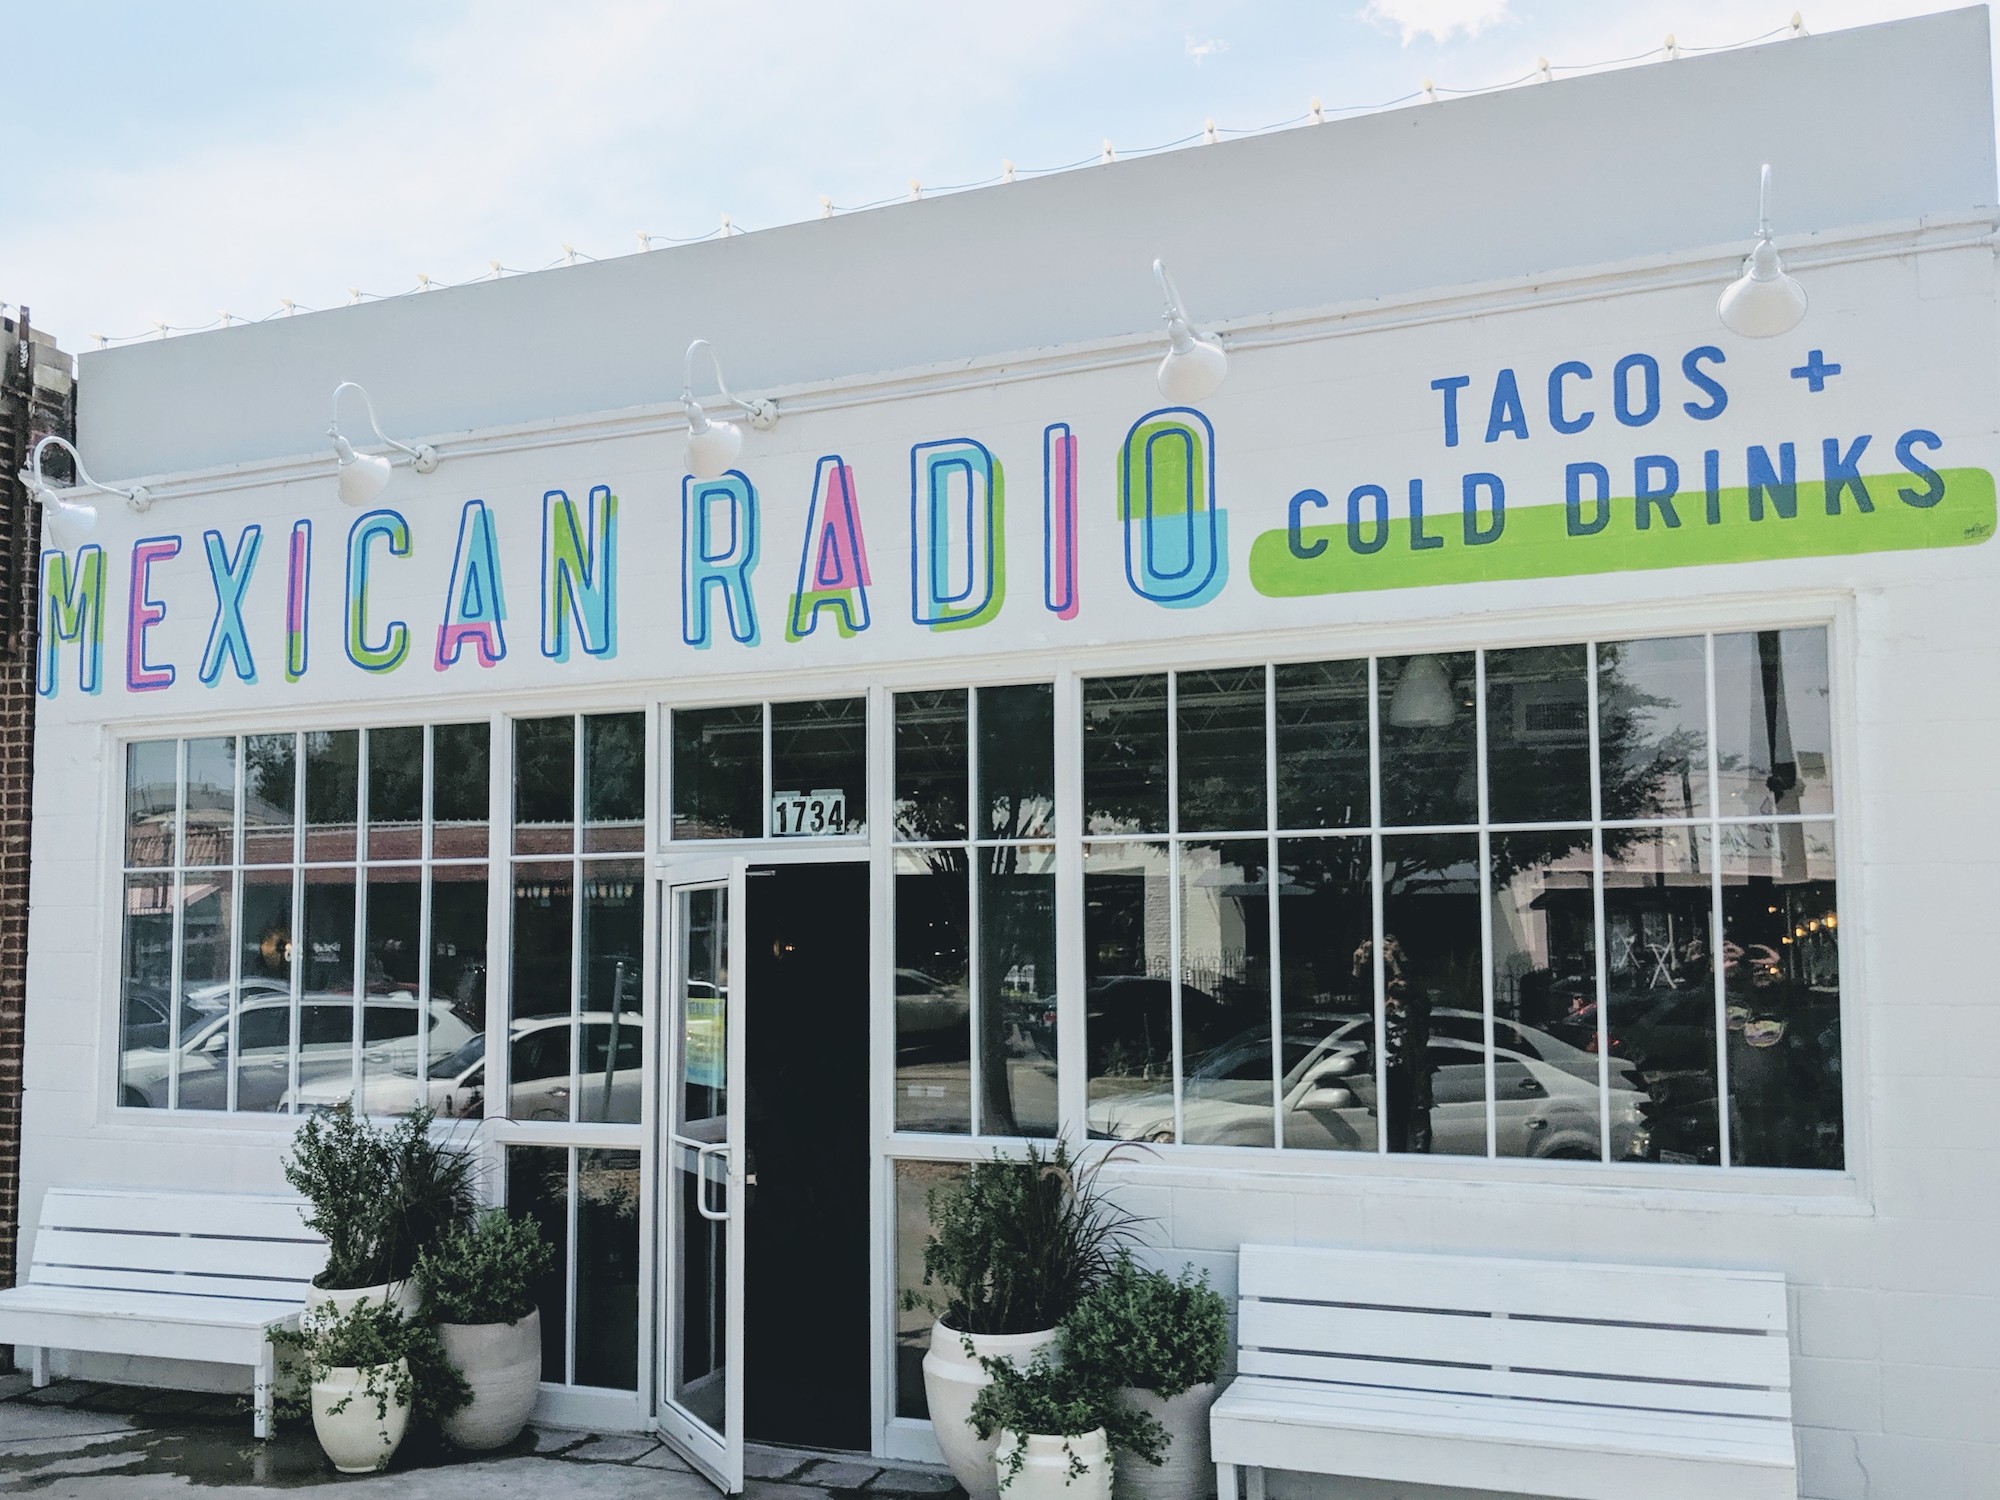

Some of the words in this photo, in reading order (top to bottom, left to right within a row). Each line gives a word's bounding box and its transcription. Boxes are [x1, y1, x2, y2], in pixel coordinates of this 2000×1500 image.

[1431, 345, 1728, 447] TACOS
[1790, 349, 1842, 393] +
[1287, 471, 1505, 560] COLD
[1565, 429, 1946, 537] DRINKS
[36, 484, 618, 700] MEXICAN
[681, 406, 1230, 651] RADIO
[775, 799, 844, 833] 1734
